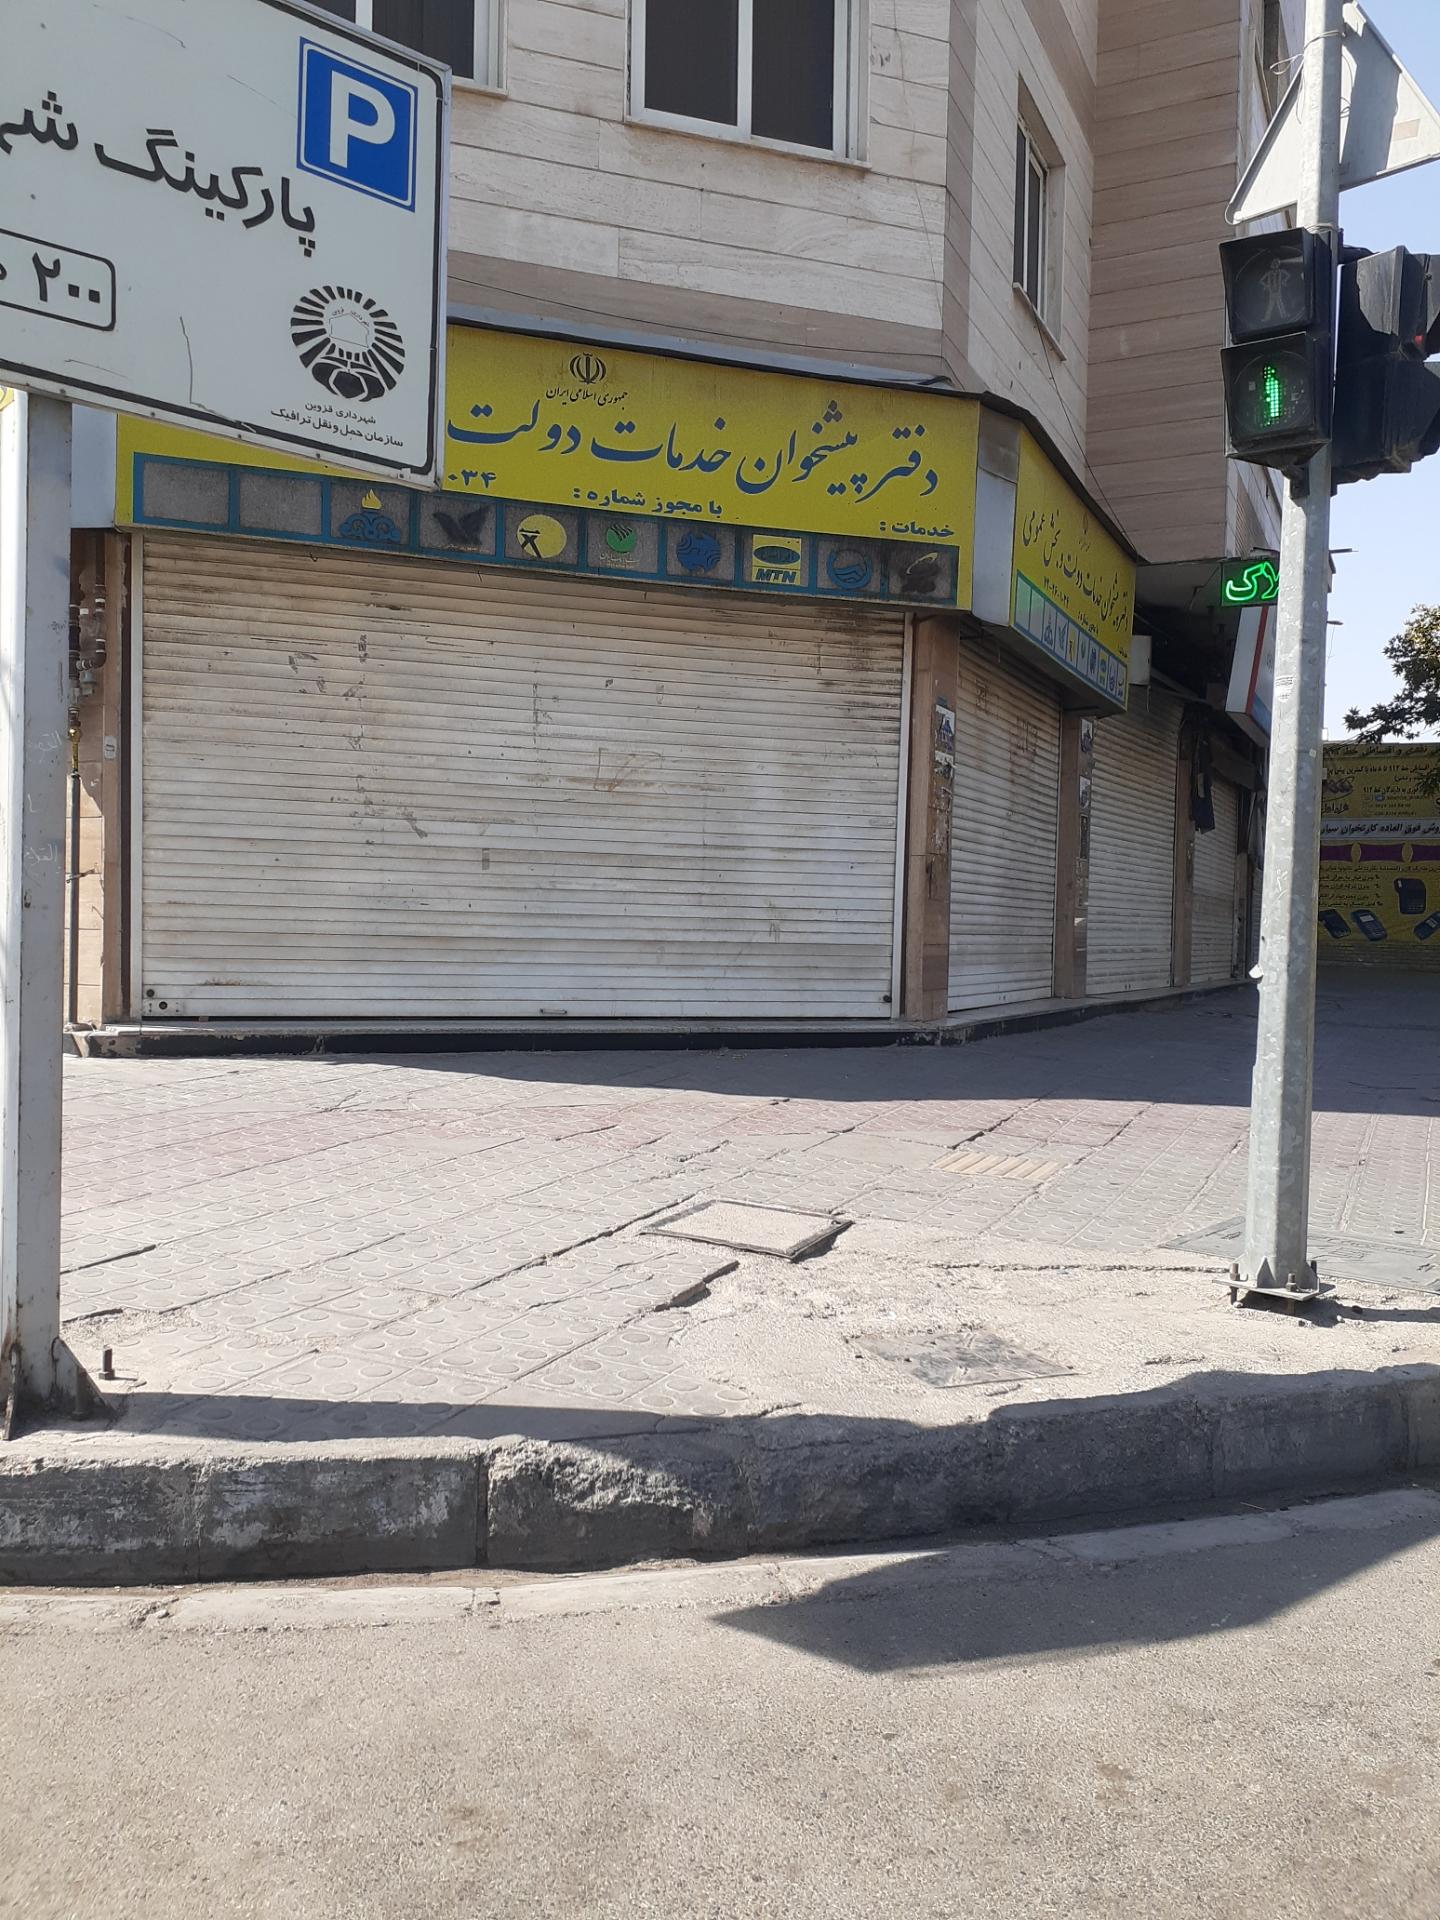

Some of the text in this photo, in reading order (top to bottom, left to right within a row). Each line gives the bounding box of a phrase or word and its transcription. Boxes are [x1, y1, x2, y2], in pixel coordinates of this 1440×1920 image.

[329, 70, 396, 169] P
[94, 128, 316, 258] پارکینگ
[32, 252, 101, 304] ۲۰۰
[545, 386, 628, 411] جمهوری اسلامی ایران
[270, 408, 312, 425] ترافیک
[304, 401, 376, 424] شهرداری قزوین
[340, 424, 363, 437] حمل
[364, 430, 404, 447] سازمان
[446, 399, 939, 503] دفتر پیشخوان خدمات دولت
[652, 497, 703, 514] مجوز
[708, 500, 723, 518] با
[755, 568, 797, 583] MTN
